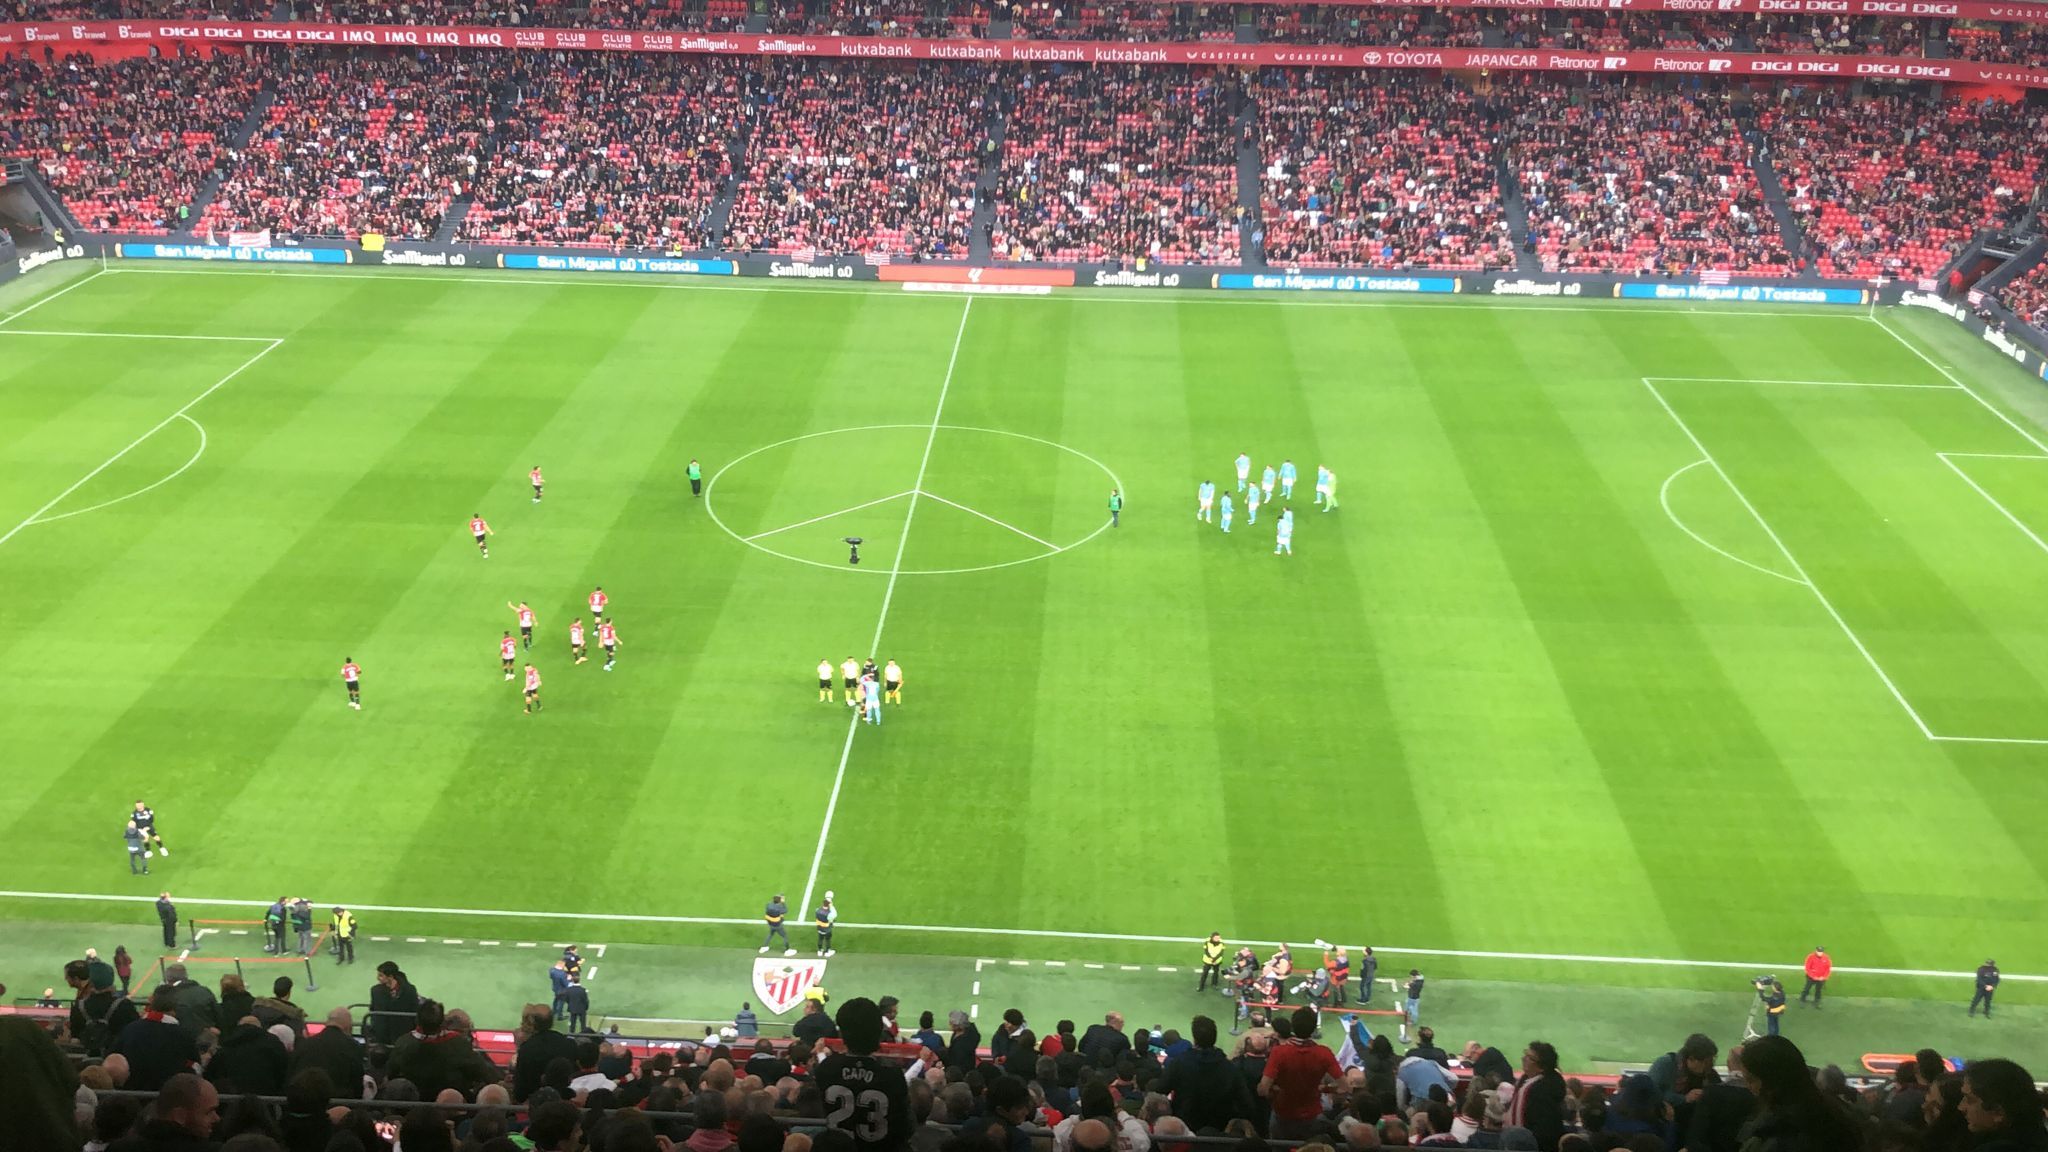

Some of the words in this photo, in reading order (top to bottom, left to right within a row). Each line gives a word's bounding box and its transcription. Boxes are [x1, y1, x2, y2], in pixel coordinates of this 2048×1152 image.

[1759, 0, 1800, 10] DIGI
[1806, 1, 1848, 10] DIGI
[1863, 2, 1907, 12] DIGI
[1912, 3, 1958, 14] DIGI
[160, 28, 199, 38] DIGI
[204, 28, 242, 38] DIGI
[253, 29, 291, 39] DIGI
[296, 30, 335, 40] DIGI
[342, 31, 376, 43] IMQ
[384, 32, 418, 44] IMQ
[426, 32, 459, 45] IMQ
[469, 33, 503, 46] IMQ
[514, 32, 544, 41] CLUB
[556, 33, 586, 42] CLUB
[602, 34, 631, 43] CLUB
[643, 35, 672, 44] CLUB
[680, 38, 728, 51] SanMiguel
[757, 40, 805, 53] SanMiguel
[841, 42, 911, 56] kutxabank
[930, 44, 1001, 58] kutxabank
[1013, 46, 1084, 60] kutxabank
[1095, 47, 1166, 61] kutxabank
[1202, 52, 1254, 60] CASTORE
[1290, 53, 1343, 61] CASTORE
[1386, 53, 1442, 65] TOYOTA
[1465, 54, 1537, 66] JAPANCAR
[1550, 56, 1599, 68] Petronor
[1654, 58, 1704, 70] Petronor
[1752, 61, 1792, 71] DIGI
[1797, 62, 1839, 72] DIGI
[1857, 64, 1900, 74] DIGI
[1906, 66, 1950, 77] DIGI
[154, 245, 183, 257] San
[186, 246, 232, 259] Miguel
[252, 248, 313, 261] Tostada
[382, 250, 446, 266] SanMiguel
[537, 256, 565, 269] San
[568, 256, 616, 271] Miguel
[637, 259, 699, 272] Tostada
[769, 262, 833, 278] SanMiguel
[1094, 271, 1159, 287] SanMiguel
[1252, 275, 1282, 288] San
[1285, 276, 1334, 290] Miguel
[1357, 277, 1420, 291] Tostada
[1491, 279, 1561, 295] SanMiguel
[1656, 285, 1686, 298] San
[1689, 285, 1739, 299] Miguel
[1762, 287, 1826, 301] Tostada
[842, 1067, 874, 1083] CAPO
[824, 1085, 889, 1142] 23
